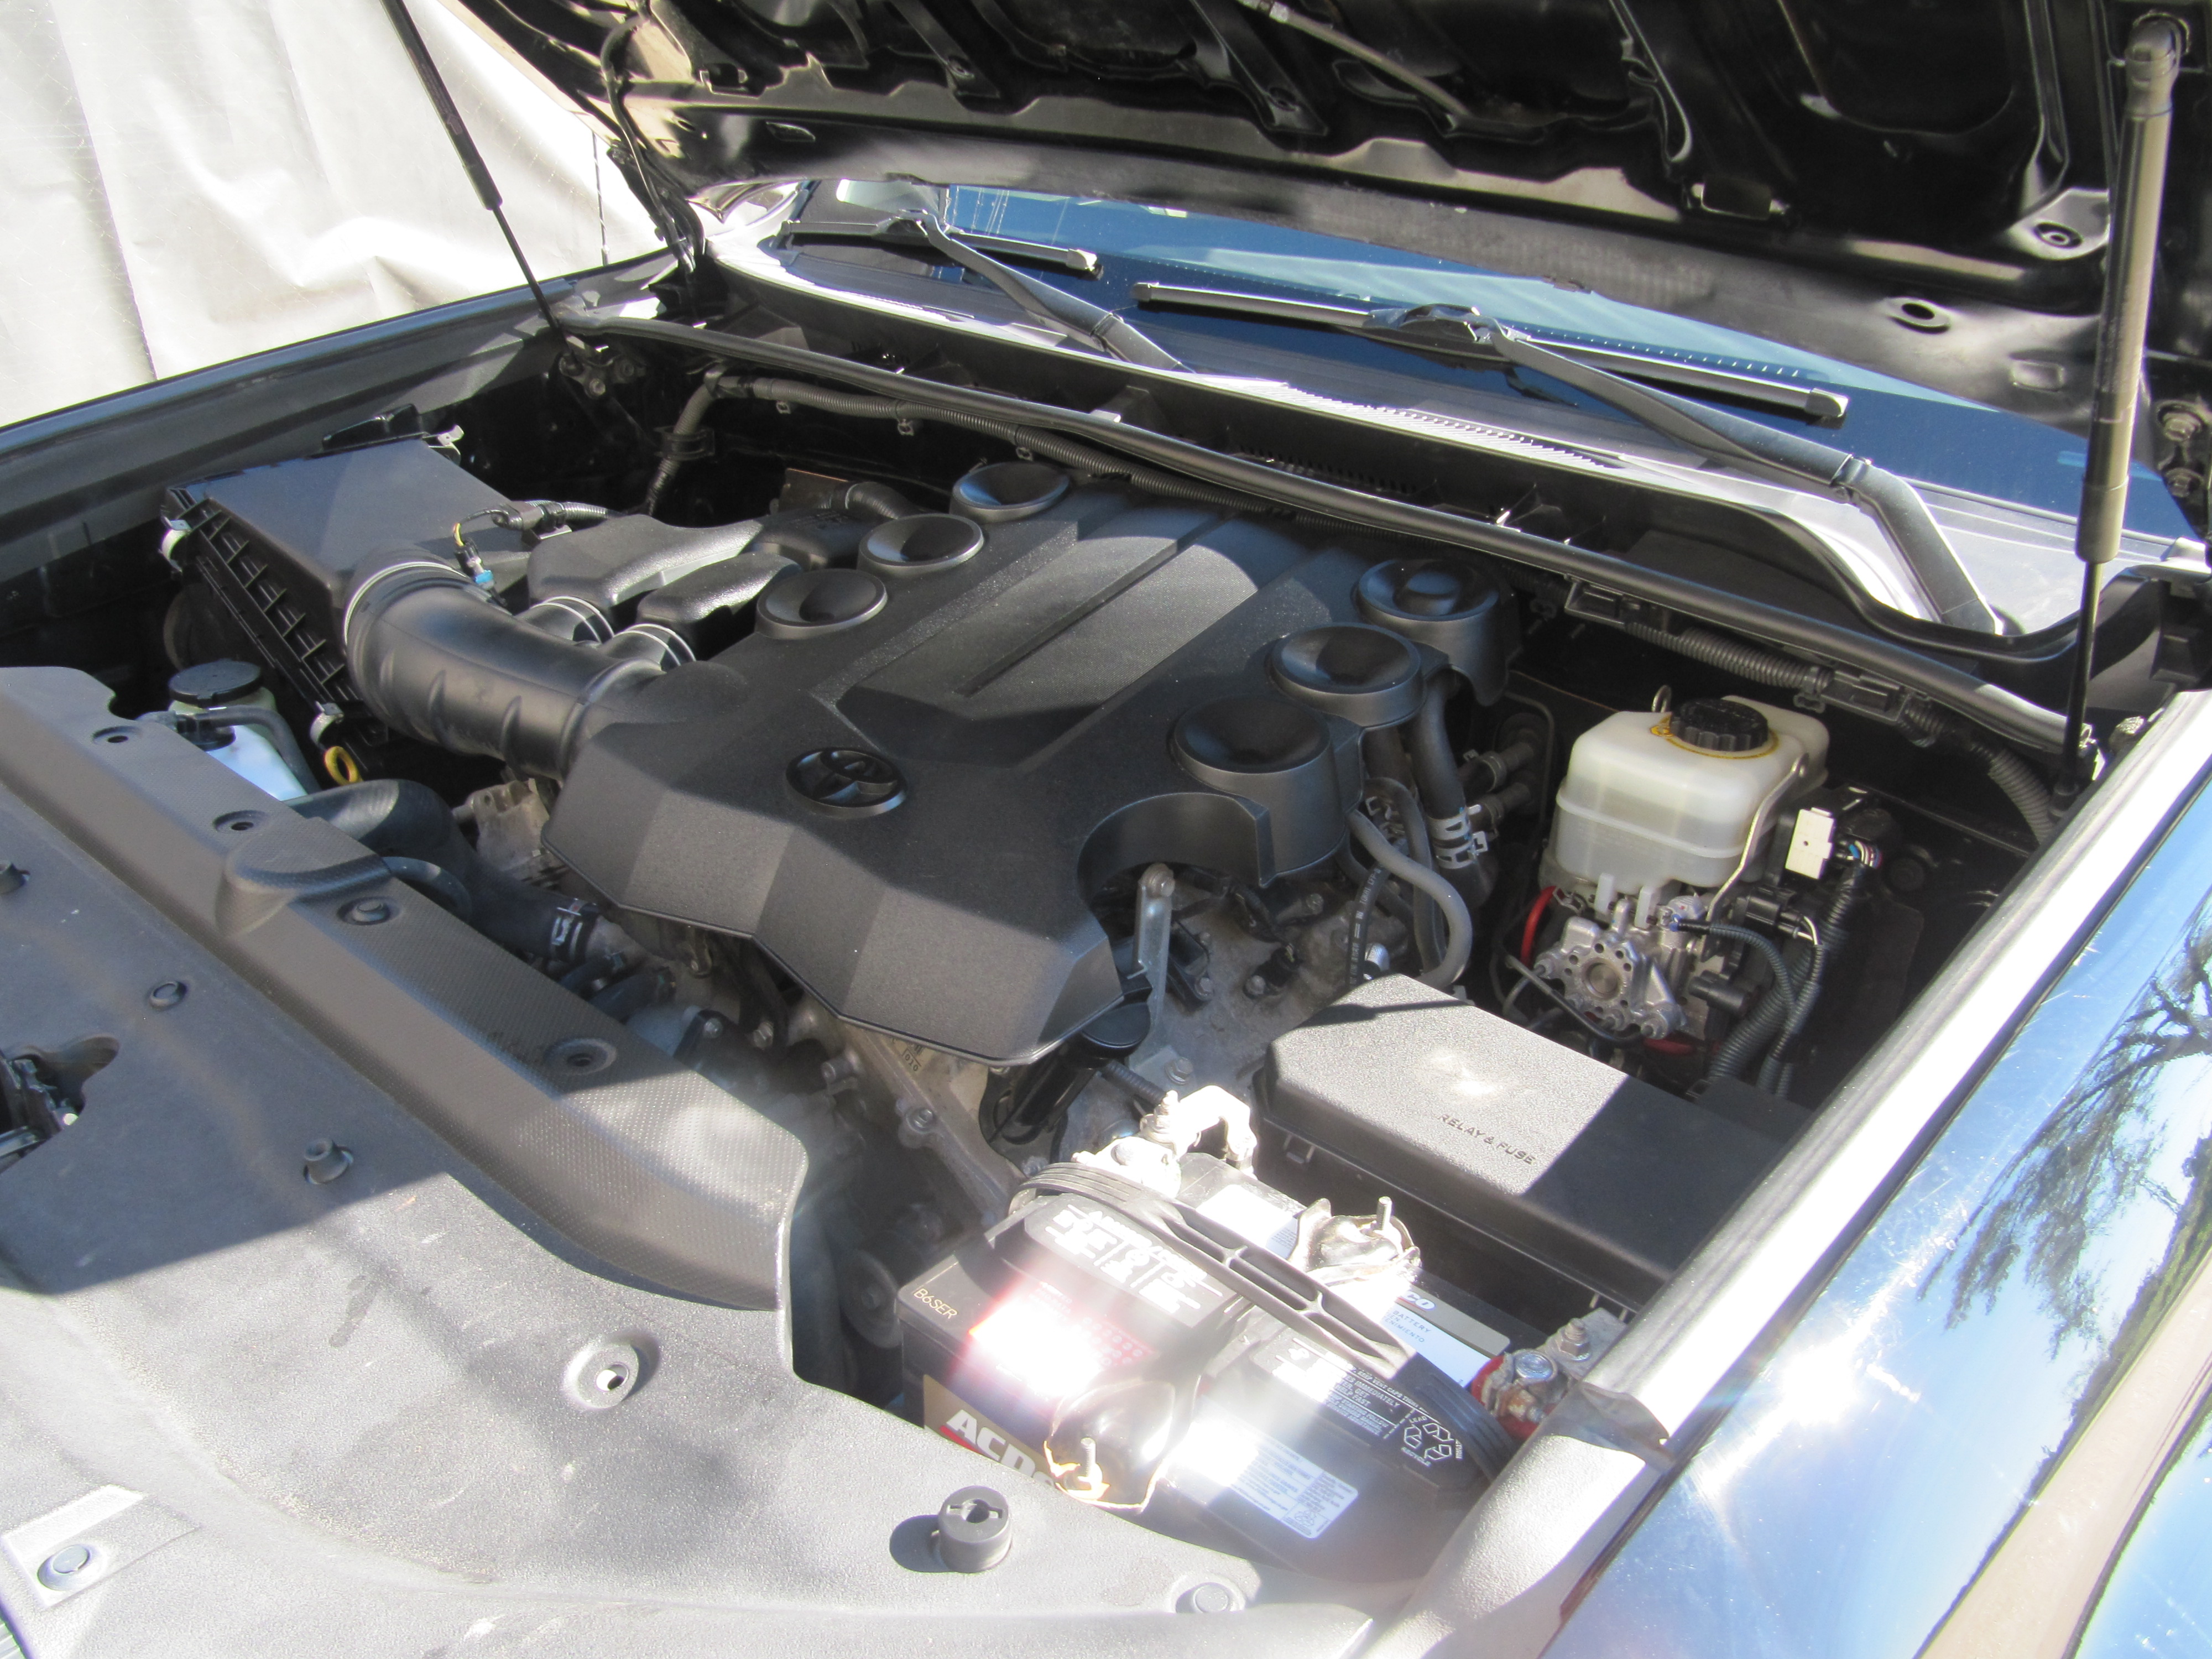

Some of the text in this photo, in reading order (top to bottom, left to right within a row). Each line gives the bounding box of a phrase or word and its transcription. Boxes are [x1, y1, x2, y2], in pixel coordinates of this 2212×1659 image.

[1438, 1114, 1536, 1165] RELAY & FUSE
[914, 1288, 958, 1319] B6SER
[1392, 1310, 1431, 1333] BATTERY
[1336, 1384, 1353, 1396] HELP
[1353, 1395, 1371, 1407] FAST
[1355, 1381, 1401, 1408] IMMEDIATELY
[1409, 1416, 1428, 1425] LEAD
[1401, 1446, 1431, 1467] RECYCLE
